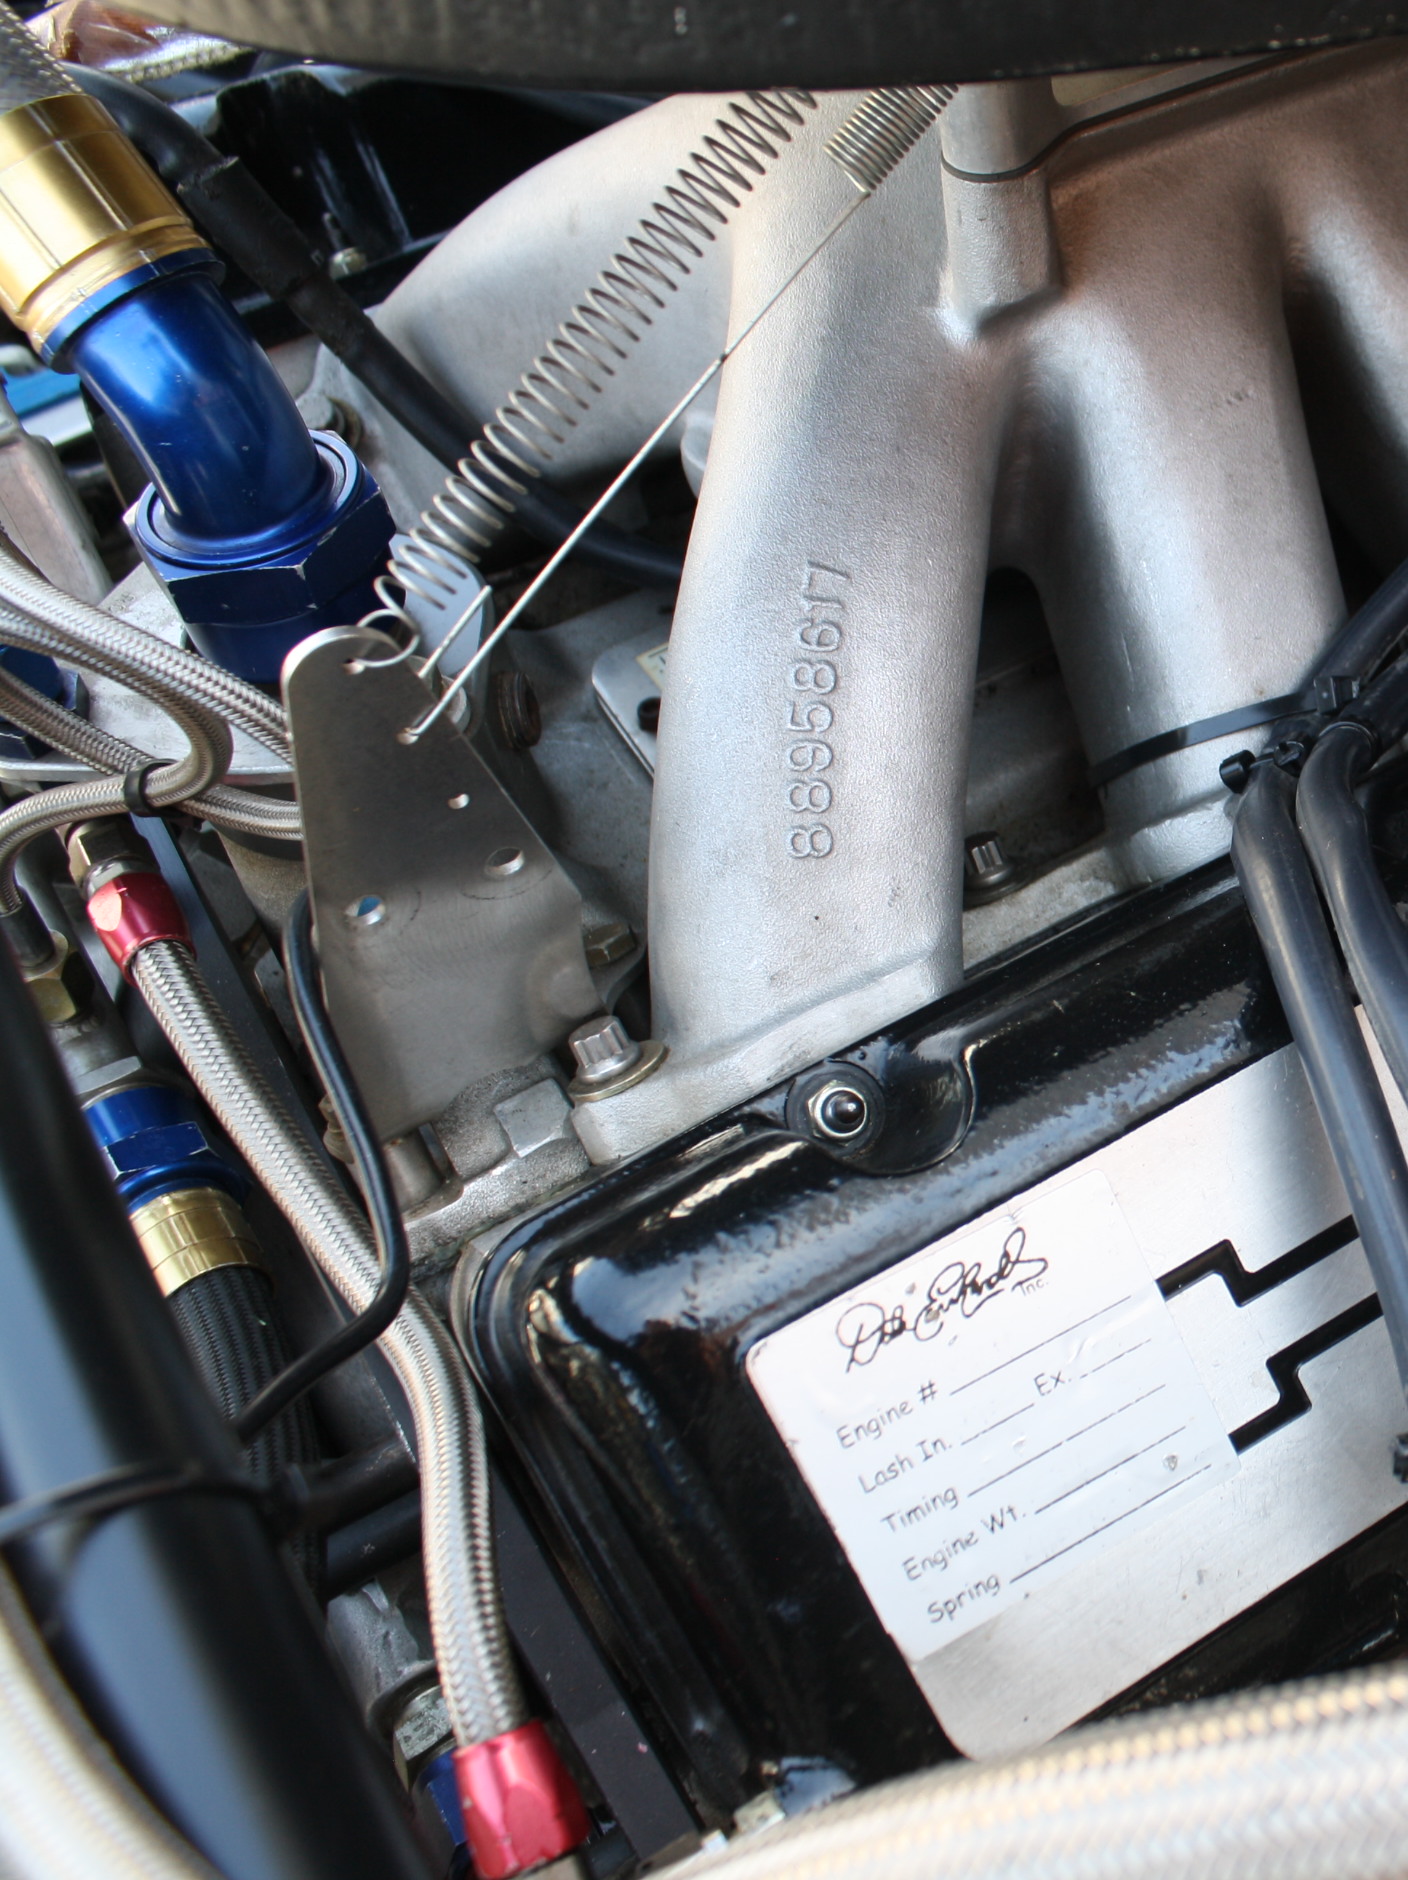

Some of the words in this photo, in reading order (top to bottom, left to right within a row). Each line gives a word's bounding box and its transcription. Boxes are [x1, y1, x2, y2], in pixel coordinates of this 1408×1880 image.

[787, 560, 850, 859] 88958617
[836, 1400, 914, 1449] Engine
[917, 1379, 938, 1404] #
[858, 1454, 914, 1493] Lash
[916, 1437, 952, 1462] In.
[1033, 1371, 1073, 1396] Ex.
[880, 1486, 959, 1533] Timing
[902, 1530, 979, 1581] Engine
[981, 1504, 1027, 1534] Wt.
[927, 1574, 1001, 1623] Spring
